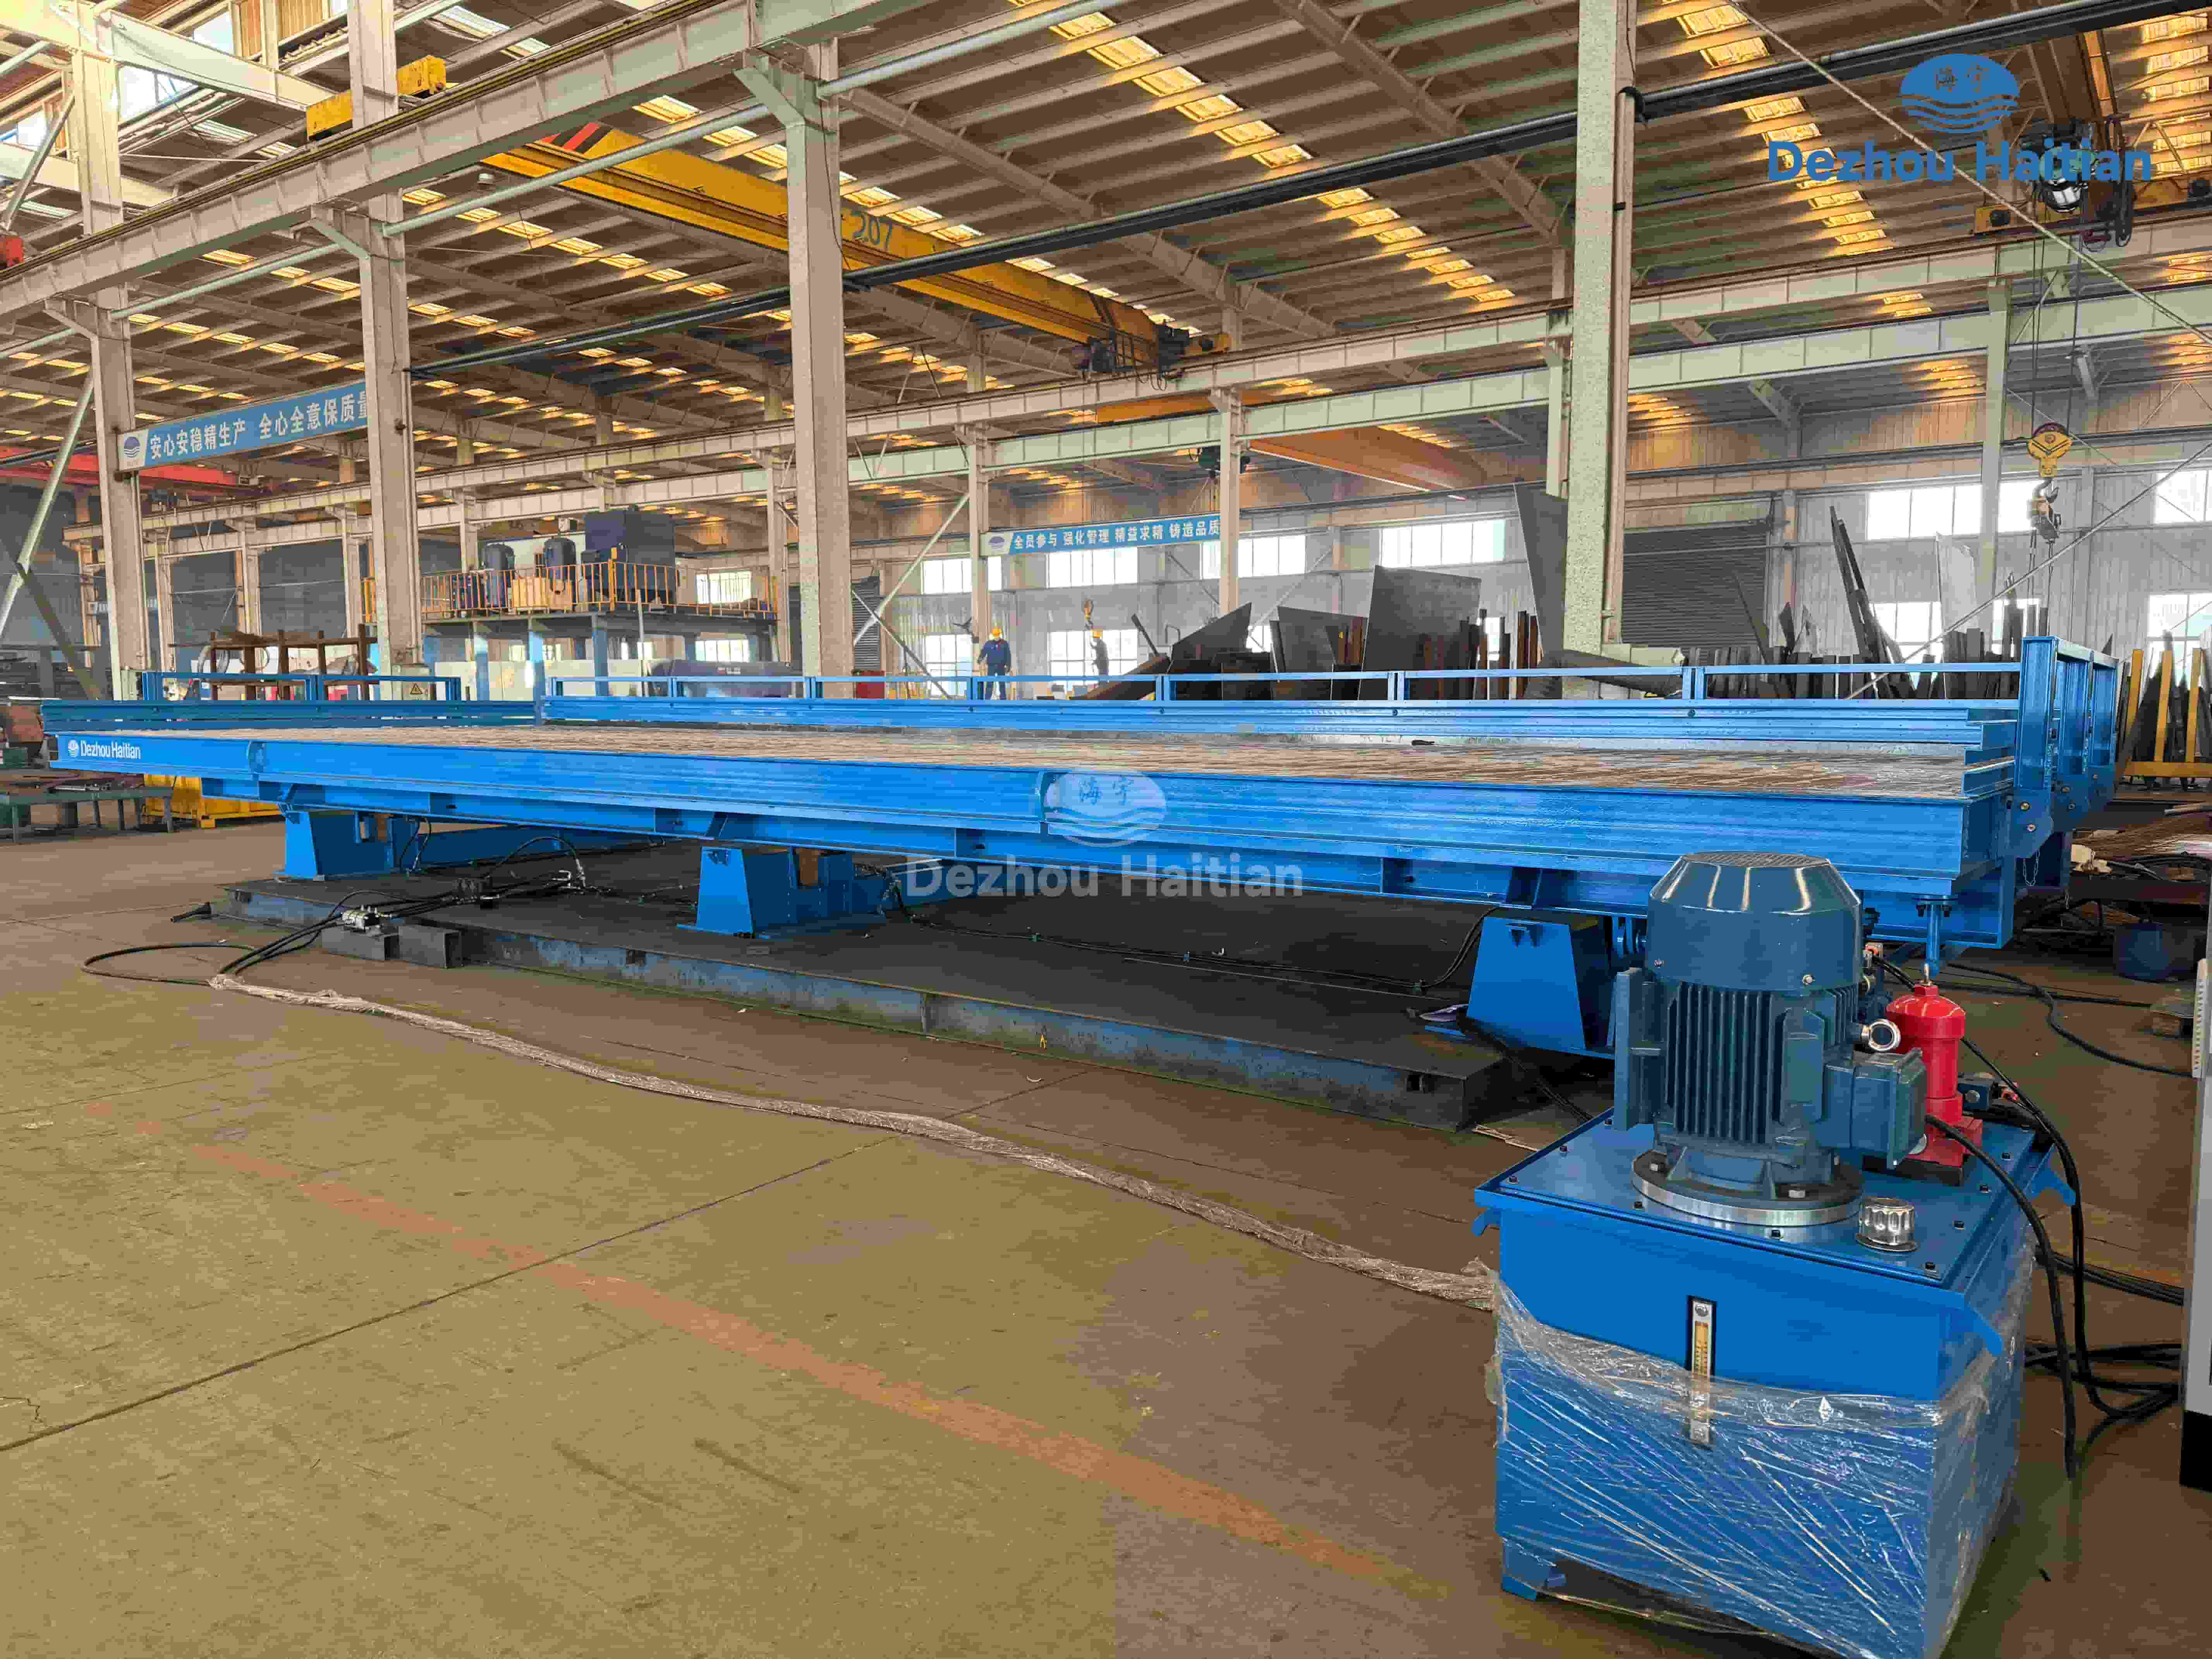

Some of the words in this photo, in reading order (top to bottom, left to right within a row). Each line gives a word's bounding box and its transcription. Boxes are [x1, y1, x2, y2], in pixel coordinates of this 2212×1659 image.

[1014, 533, 1057, 549] 全员参与
[1063, 529, 1110, 545] 强化管理
[1115, 525, 1163, 542] 精益求精
[80, 740, 111, 758] Dezhou
[111, 740, 141, 759] Haitian
